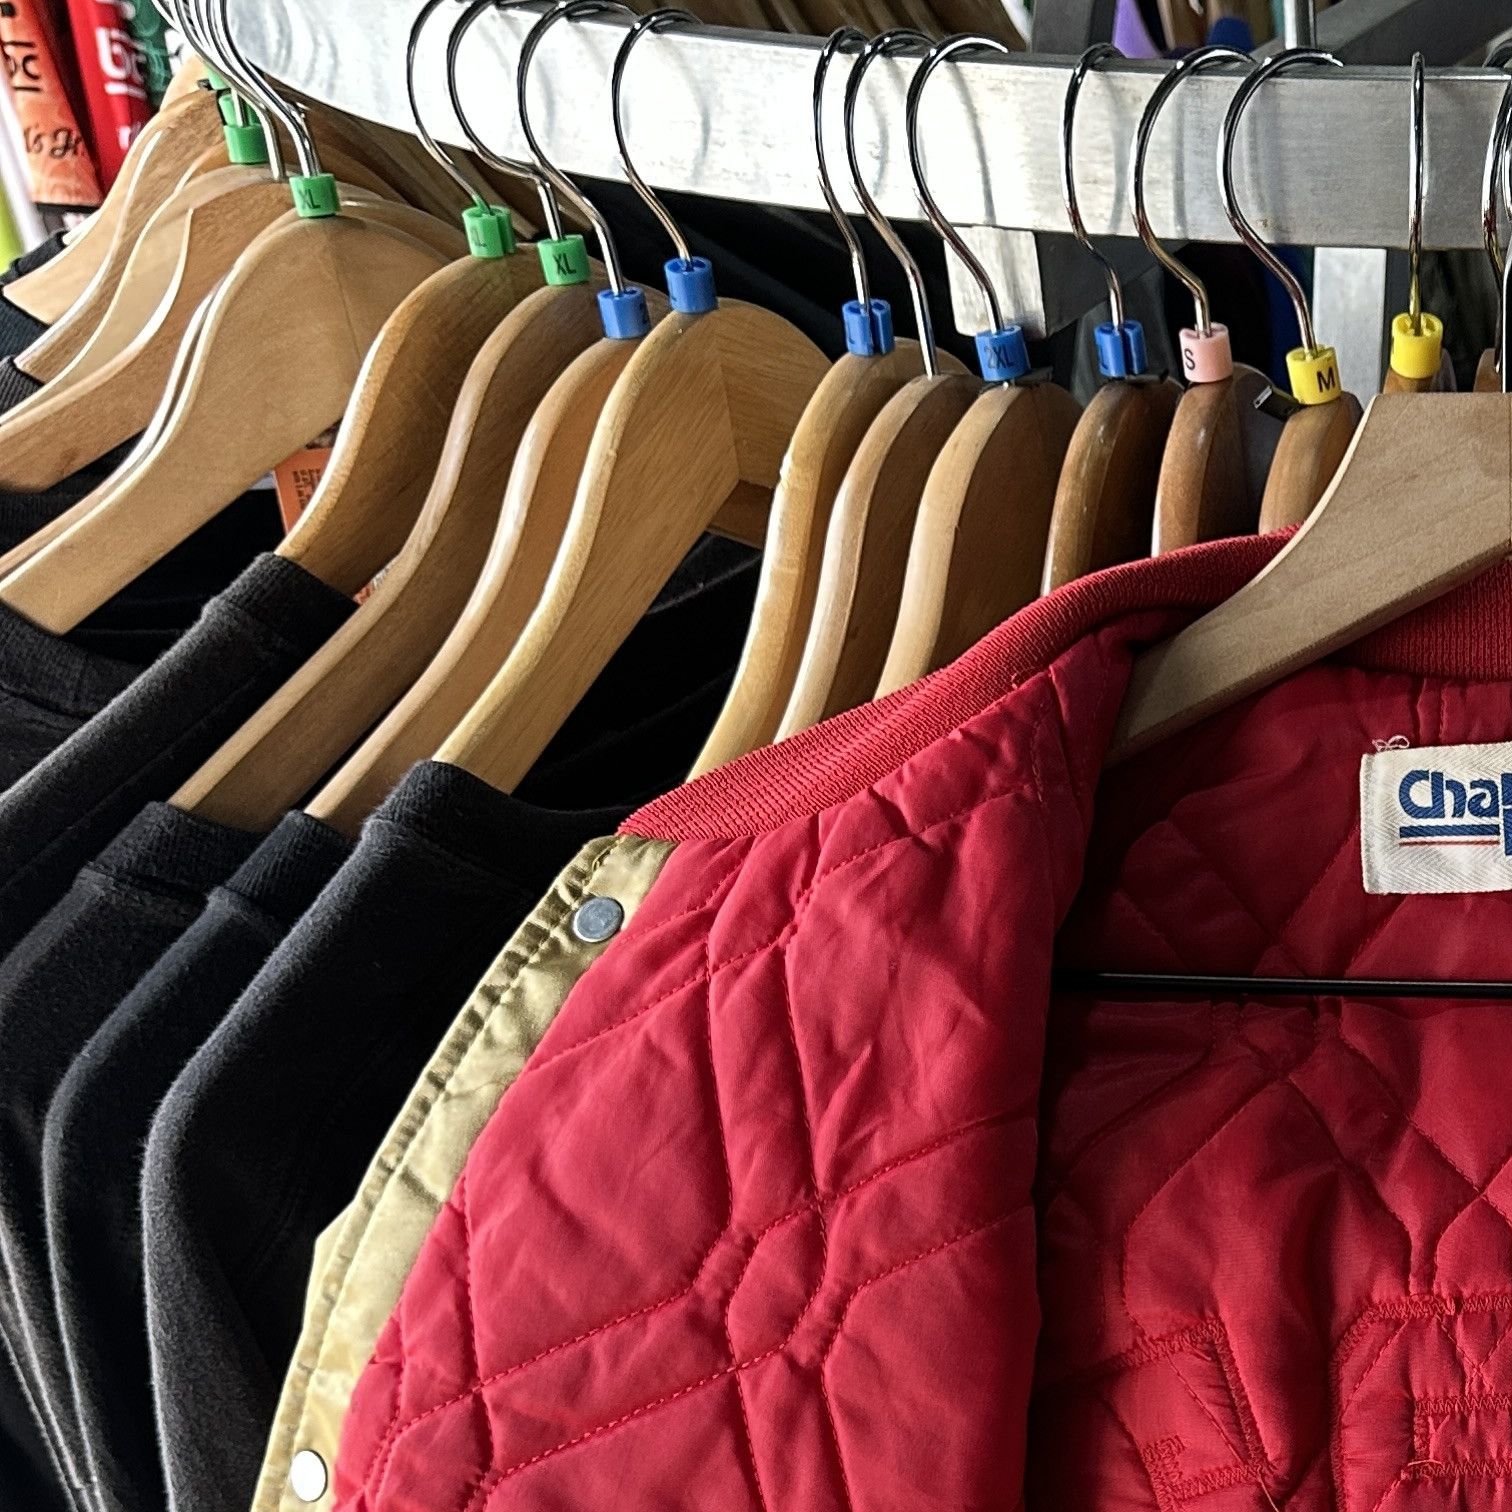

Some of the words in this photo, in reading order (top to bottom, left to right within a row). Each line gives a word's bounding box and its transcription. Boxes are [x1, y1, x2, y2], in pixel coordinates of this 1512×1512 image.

[298, 188, 322, 209] XL
[552, 253, 577, 275] XL
[1183, 347, 1196, 371] S
[1316, 370, 1336, 394] M
